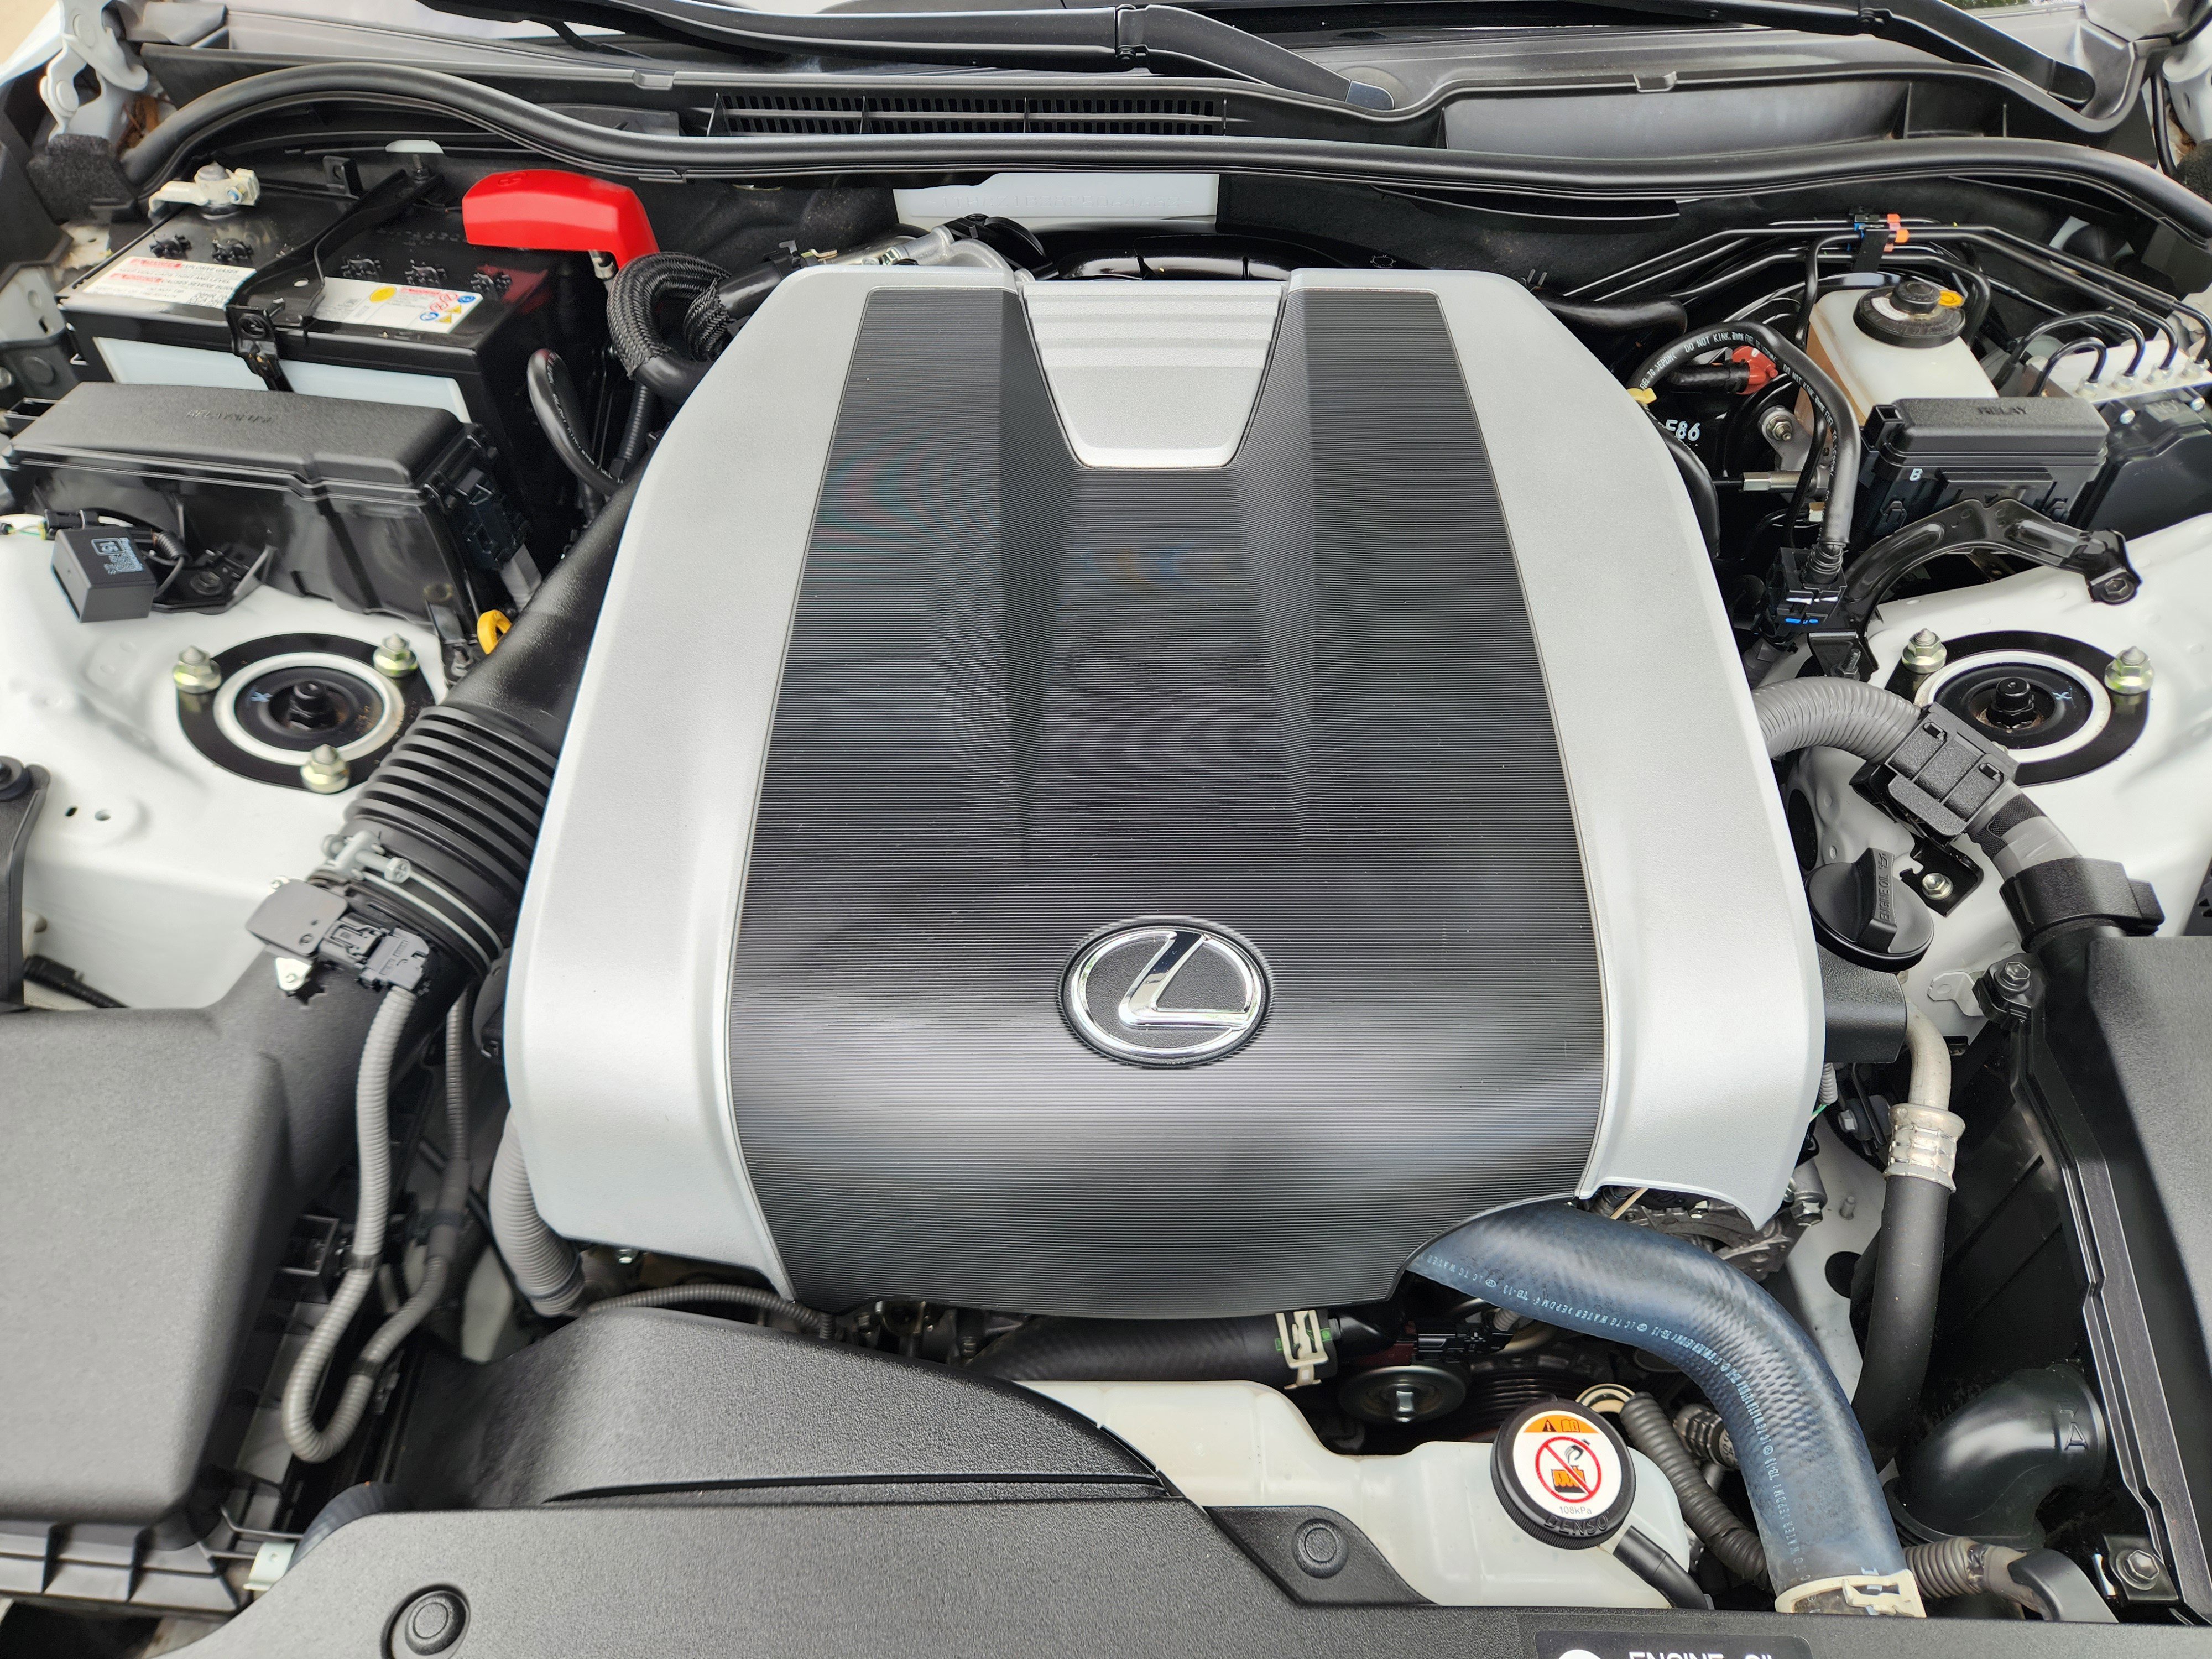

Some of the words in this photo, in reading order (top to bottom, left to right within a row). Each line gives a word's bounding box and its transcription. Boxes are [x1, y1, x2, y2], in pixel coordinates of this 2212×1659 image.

[1640, 378, 1650, 390] FUEL
[1684, 343, 1694, 353] DO
[1696, 336, 1710, 347] NOT
[1745, 333, 1755, 346] FUEL
[1792, 371, 1802, 385] NOT
[1824, 409, 1834, 427] FUEL
[1910, 468, 1923, 482] B
[1879, 874, 1890, 888] OIL
[1426, 1254, 1455, 1274] WATER
[1458, 1266, 1469, 1279] TG
[1473, 1273, 1483, 1284] LC
[1503, 1284, 1528, 1301] TB-13
[1574, 1308, 1609, 1324] WATER
[1609, 1316, 1622, 1327] TG
[1624, 1320, 1636, 1329] LC
[1759, 1434, 1771, 1445] LC
[1559, 1505, 1592, 1515] 108kPa
[1543, 1514, 1609, 1536] DENSO
[1783, 1521, 1801, 1555] WATER
